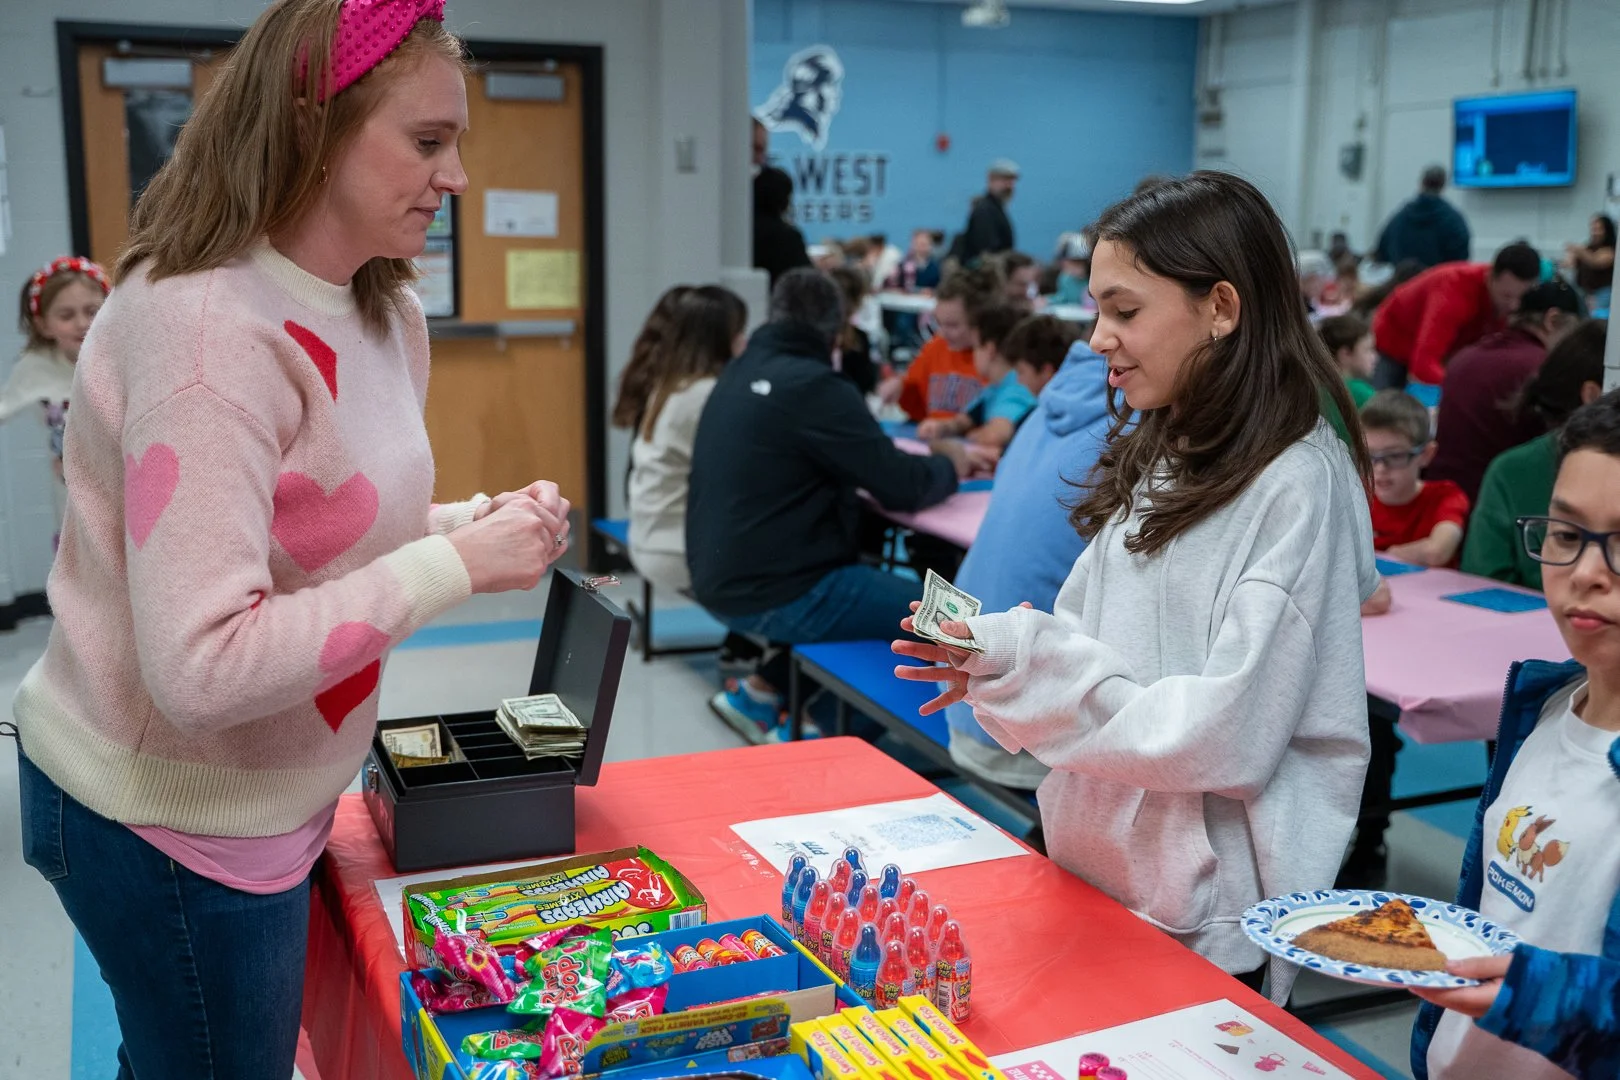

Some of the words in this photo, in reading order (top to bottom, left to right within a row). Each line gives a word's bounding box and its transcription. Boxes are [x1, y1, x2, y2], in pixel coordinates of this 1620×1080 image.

[794, 155, 889, 196] WEST
[516, 874, 563, 891] XTREMES
[518, 865, 611, 897] AIRHEADS
[1487, 865, 1534, 909] POKÉMON
[535, 891, 582, 911] XTREMES
[537, 882, 631, 925] AIRHEADS
[540, 960, 560, 1005] Ring
[556, 955, 583, 1002] Pop
[639, 1024, 665, 1036] PACK
[666, 1018, 704, 1032] VARIETY
[932, 1019, 964, 1045] Swedish
[850, 1039, 883, 1066] Swedish
[875, 1028, 908, 1056] Swedish
[910, 1032, 944, 1059] Swedish
[824, 1045, 857, 1074] Swedish
